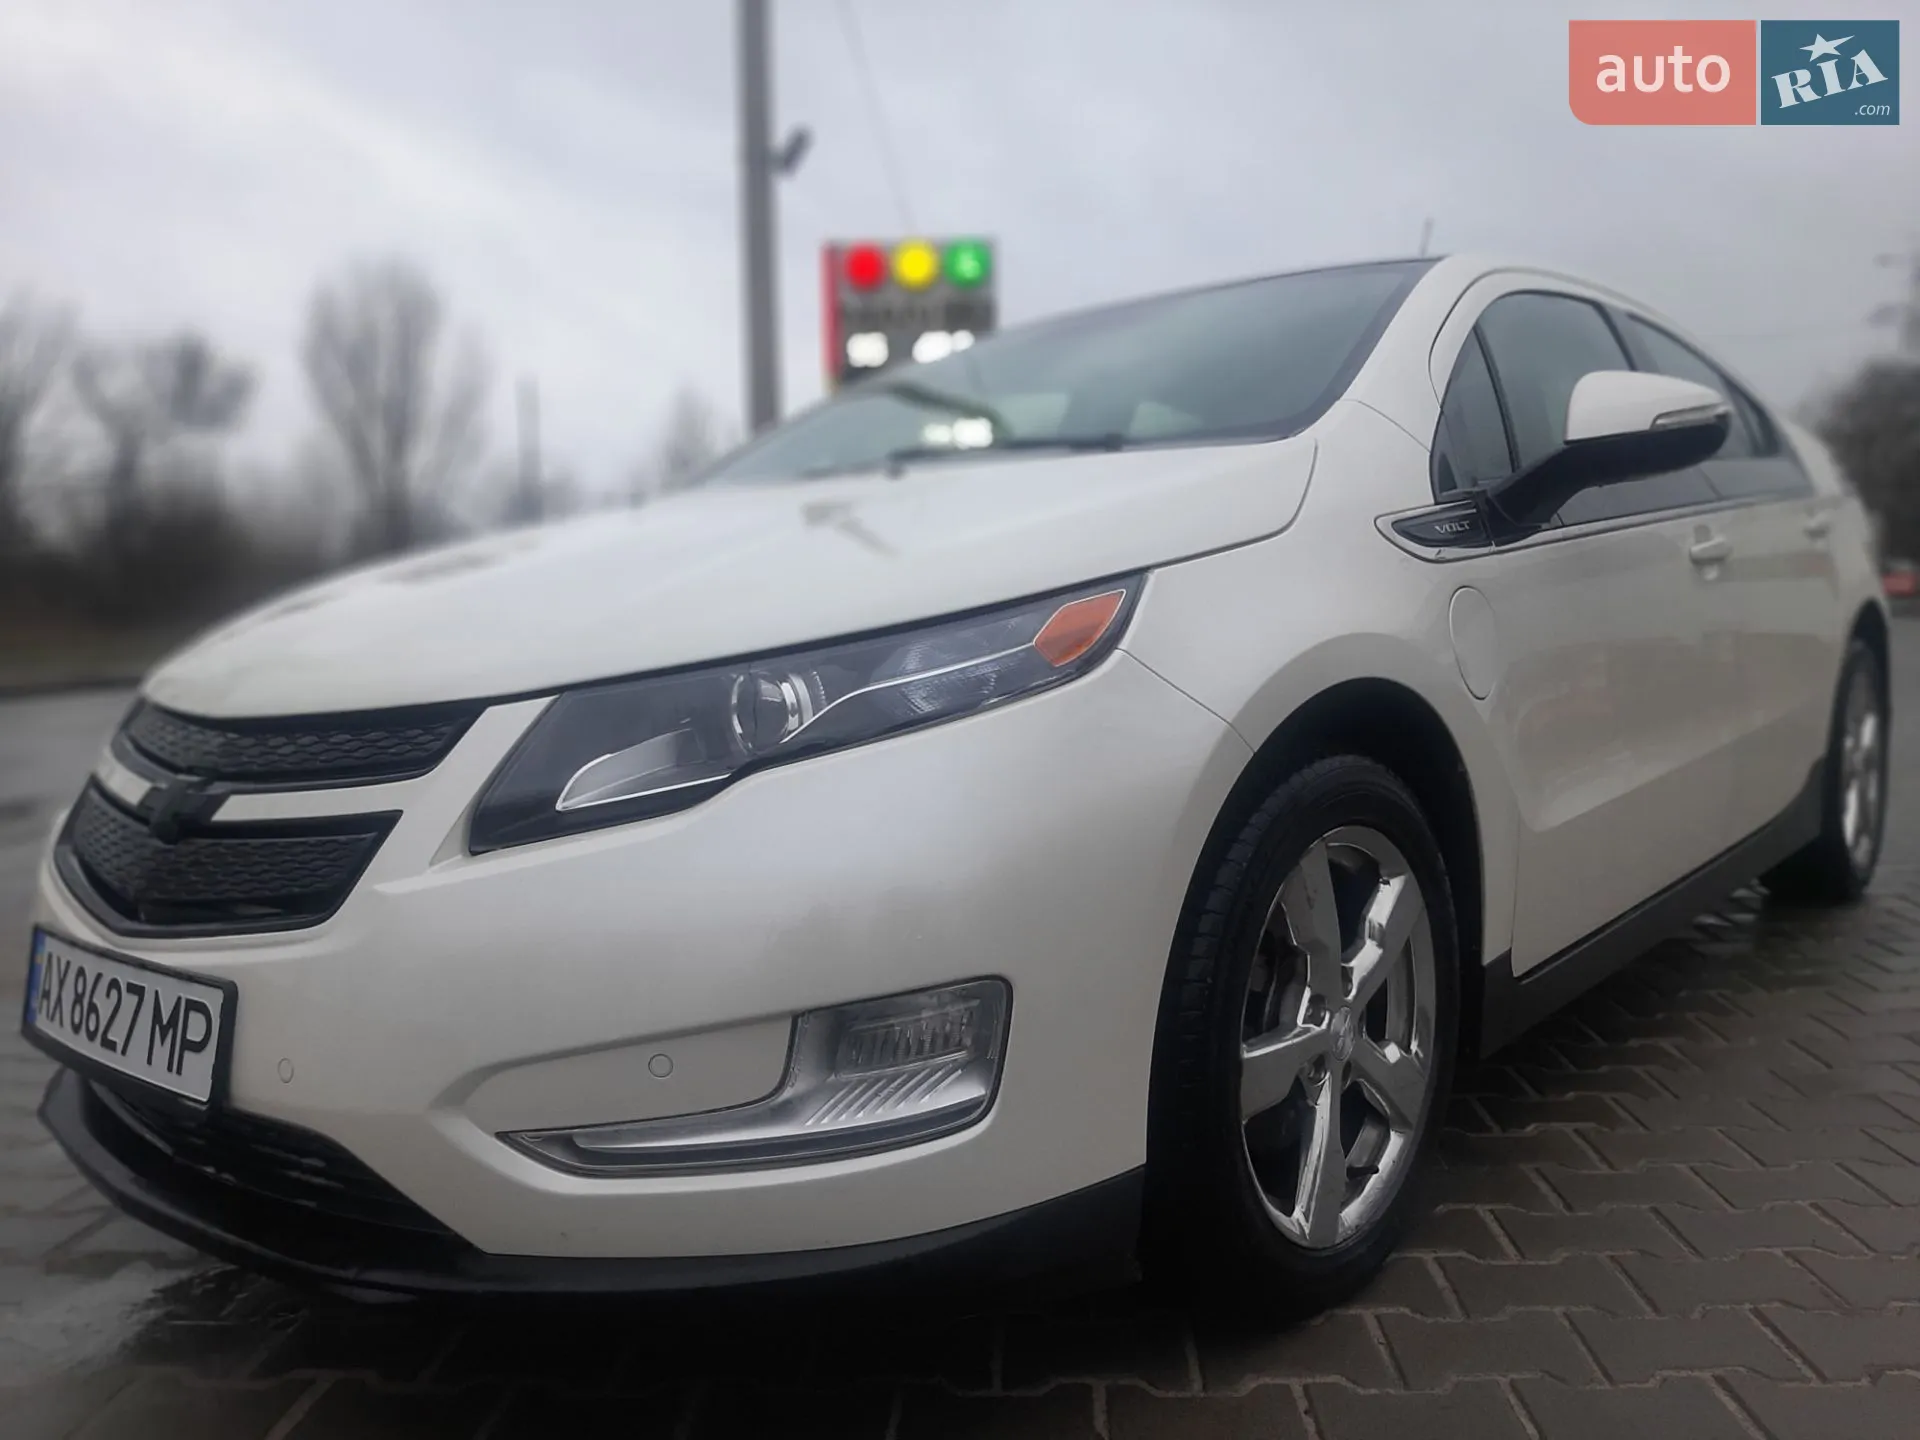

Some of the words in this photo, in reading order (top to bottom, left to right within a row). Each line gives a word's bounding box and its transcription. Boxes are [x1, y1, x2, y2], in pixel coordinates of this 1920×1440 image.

[1434, 520, 1471, 534] VOLT
[38, 951, 71, 1028] AX
[70, 966, 147, 1056] 8627
[146, 989, 213, 1076] MP
